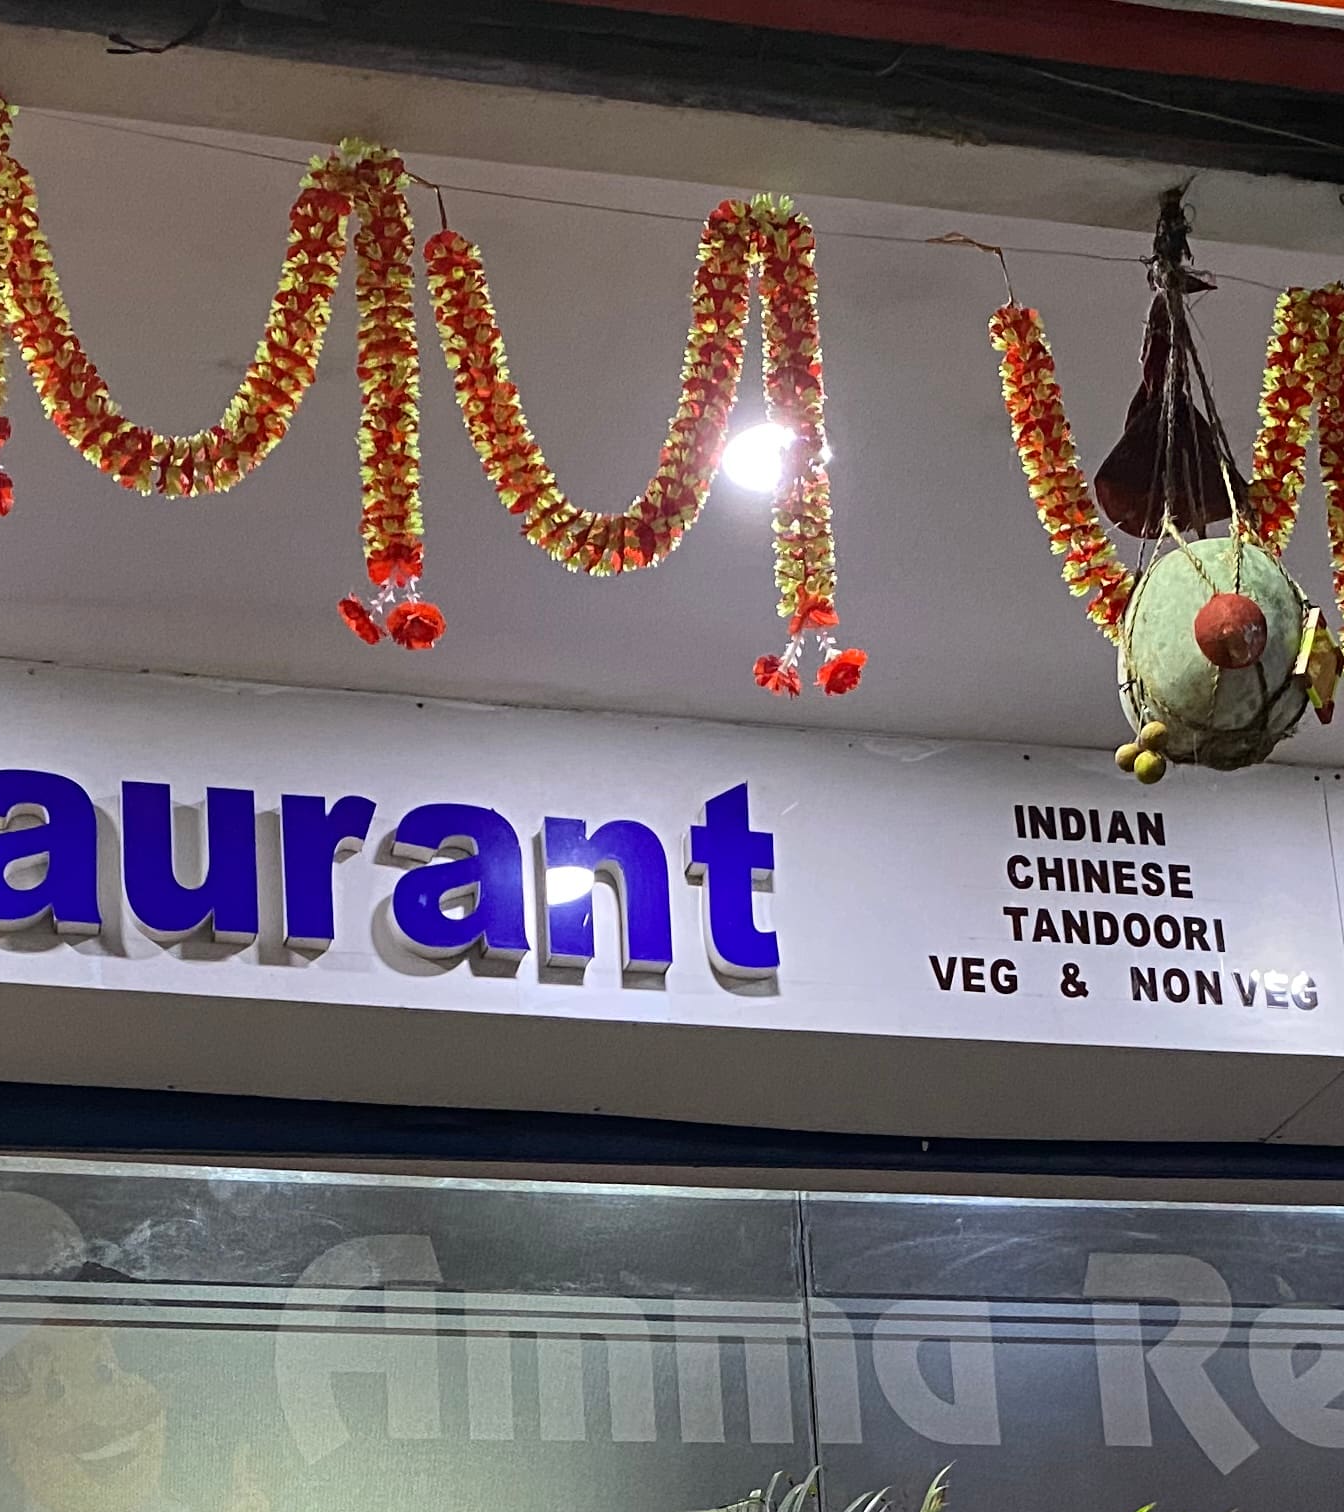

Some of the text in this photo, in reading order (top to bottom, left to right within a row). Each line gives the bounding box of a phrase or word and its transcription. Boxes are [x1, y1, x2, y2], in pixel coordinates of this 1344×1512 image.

[1014, 804, 1166, 846] INDIAN
[1006, 854, 1194, 900] CHINESE
[1002, 906, 1227, 953] TANDOORI
[928, 955, 1320, 1011] VEG & NON VEG
[274, 1233, 1001, 1464] Amma
